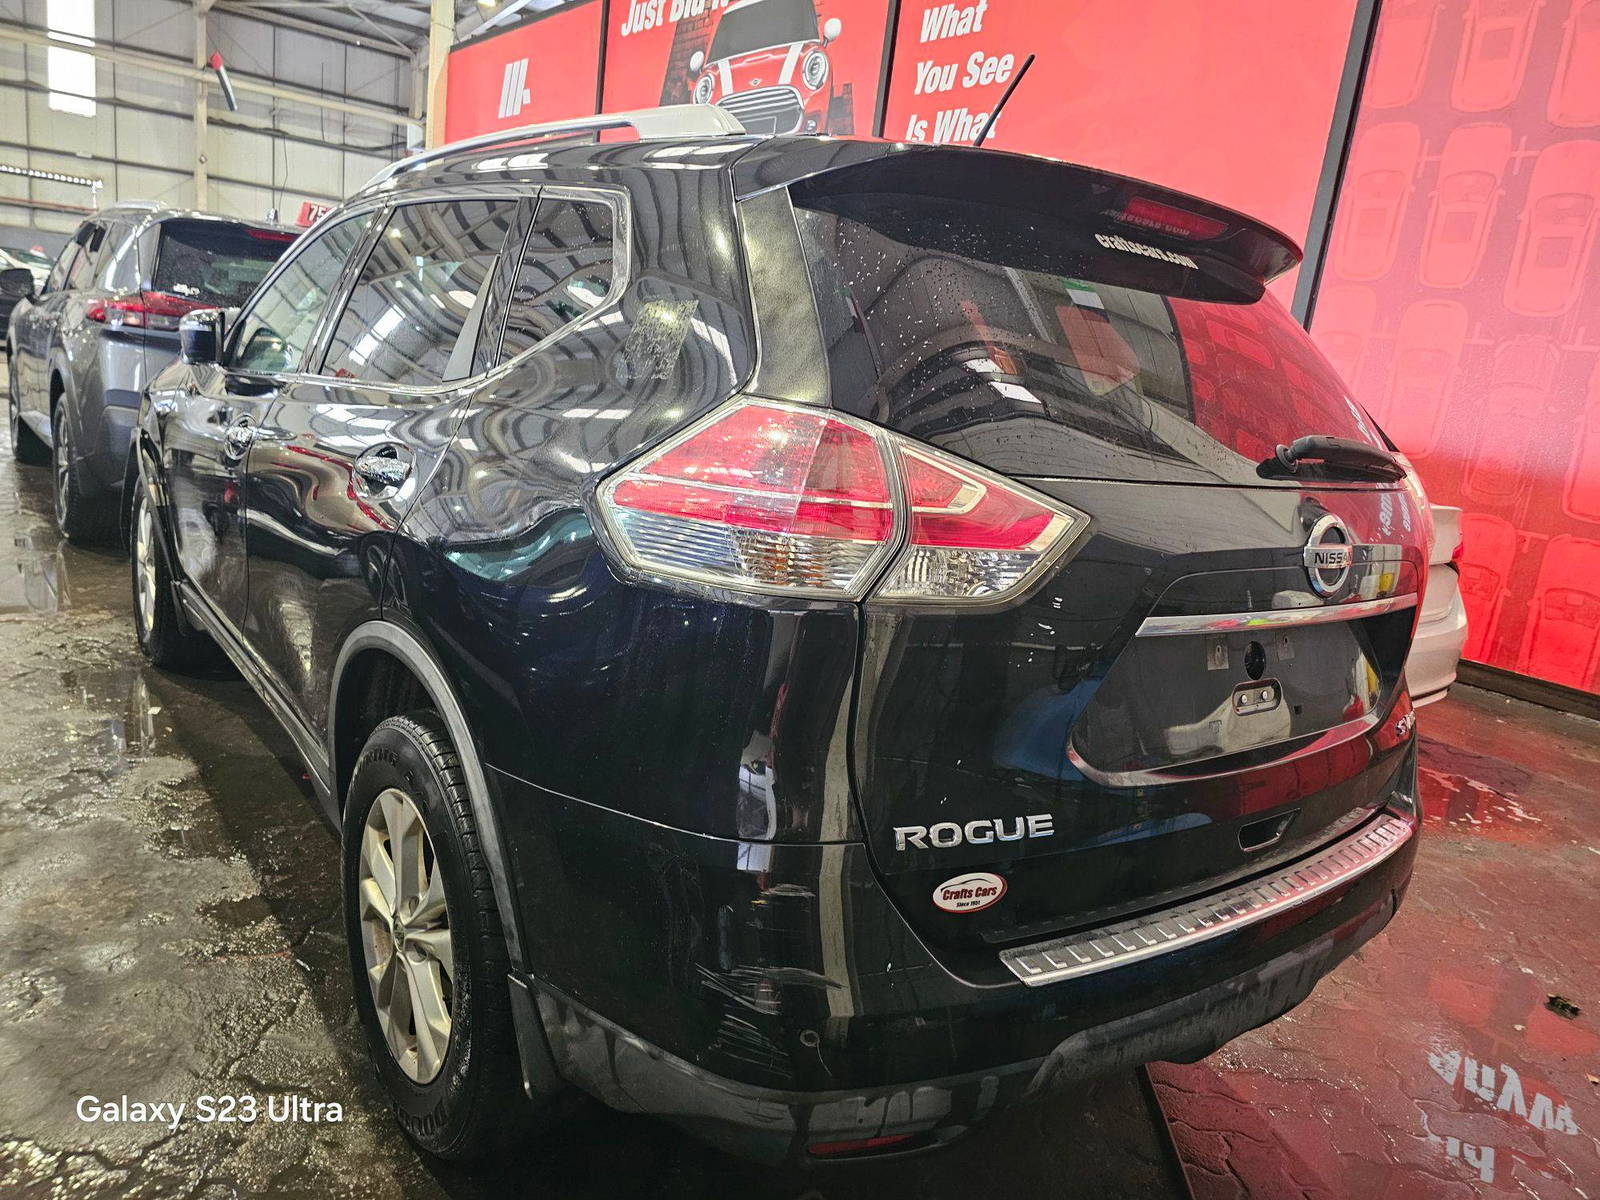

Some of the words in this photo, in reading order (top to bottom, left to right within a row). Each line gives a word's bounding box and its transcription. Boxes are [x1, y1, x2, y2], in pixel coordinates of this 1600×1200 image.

[621, 0, 666, 37] Just
[920, 0, 987, 43] What
[914, 60, 958, 95] You
[962, 51, 1014, 88] See
[905, 114, 928, 142] Is
[1314, 551, 1352, 565] NISSAN
[893, 813, 1055, 851] ROGUE
[942, 888, 974, 901] Crafts
[975, 886, 998, 898] Cars
